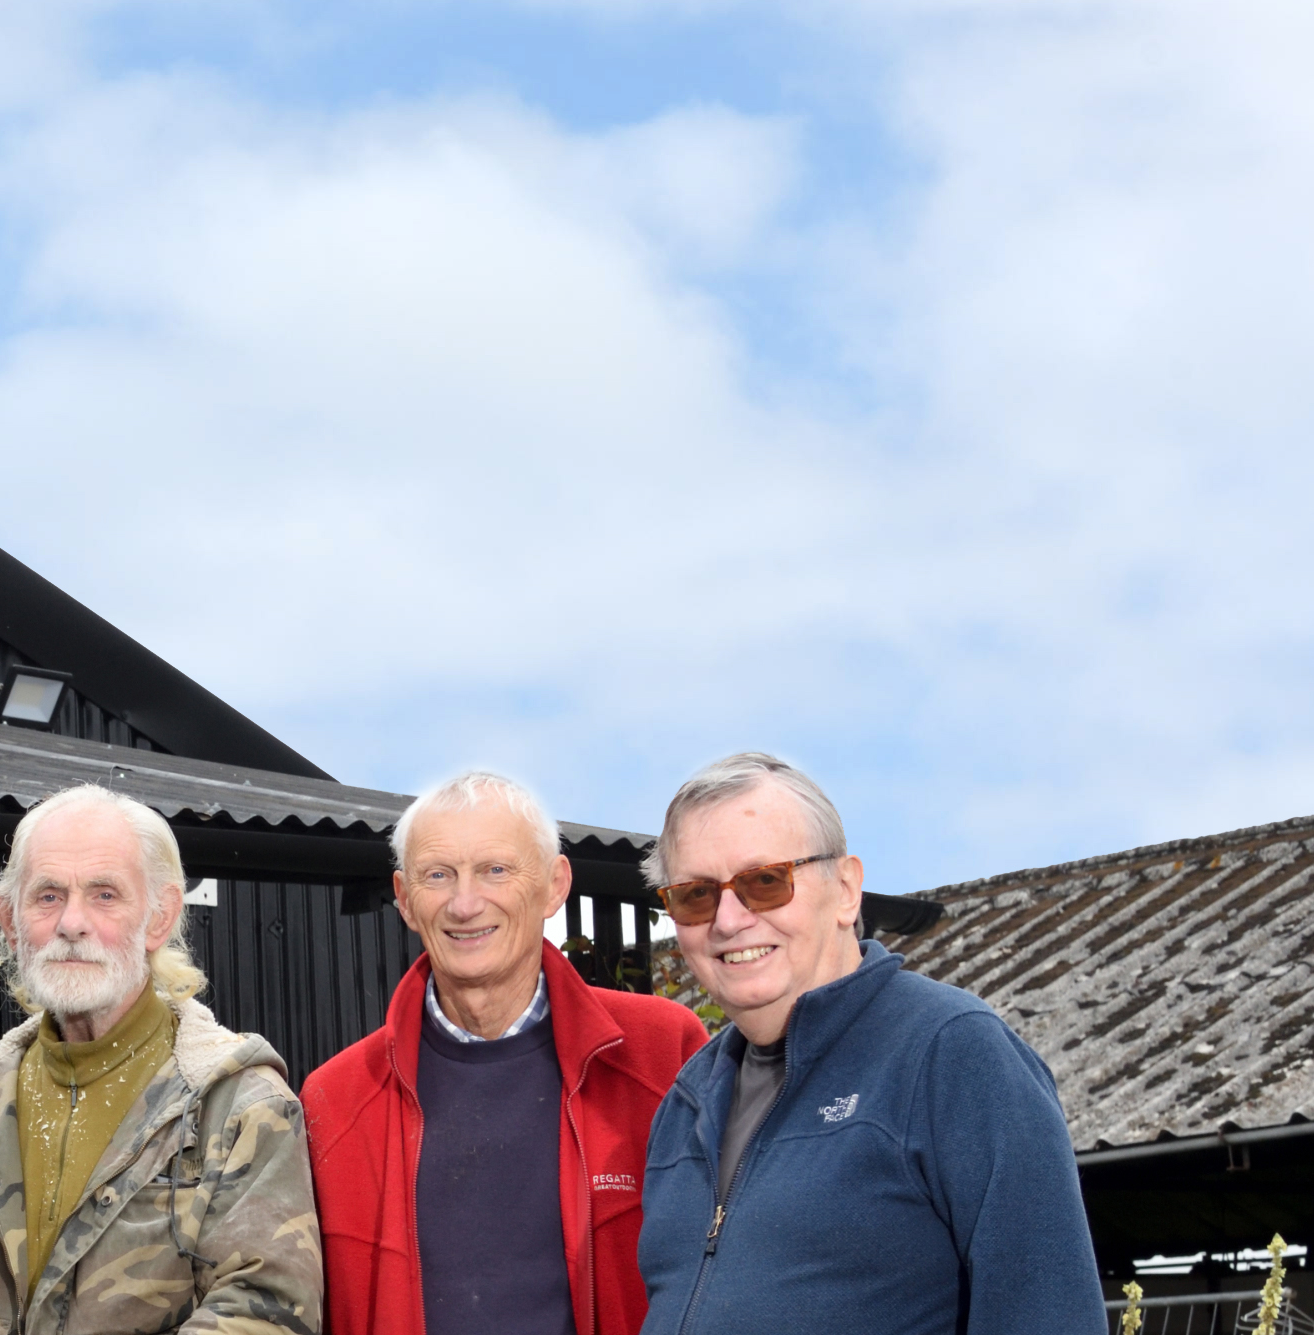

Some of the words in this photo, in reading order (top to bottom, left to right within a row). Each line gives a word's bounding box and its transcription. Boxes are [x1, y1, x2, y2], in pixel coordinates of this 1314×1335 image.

[835, 1096, 851, 1105] THE
[824, 1112, 846, 1123] FACE
[593, 1174, 636, 1184] REGATTA
